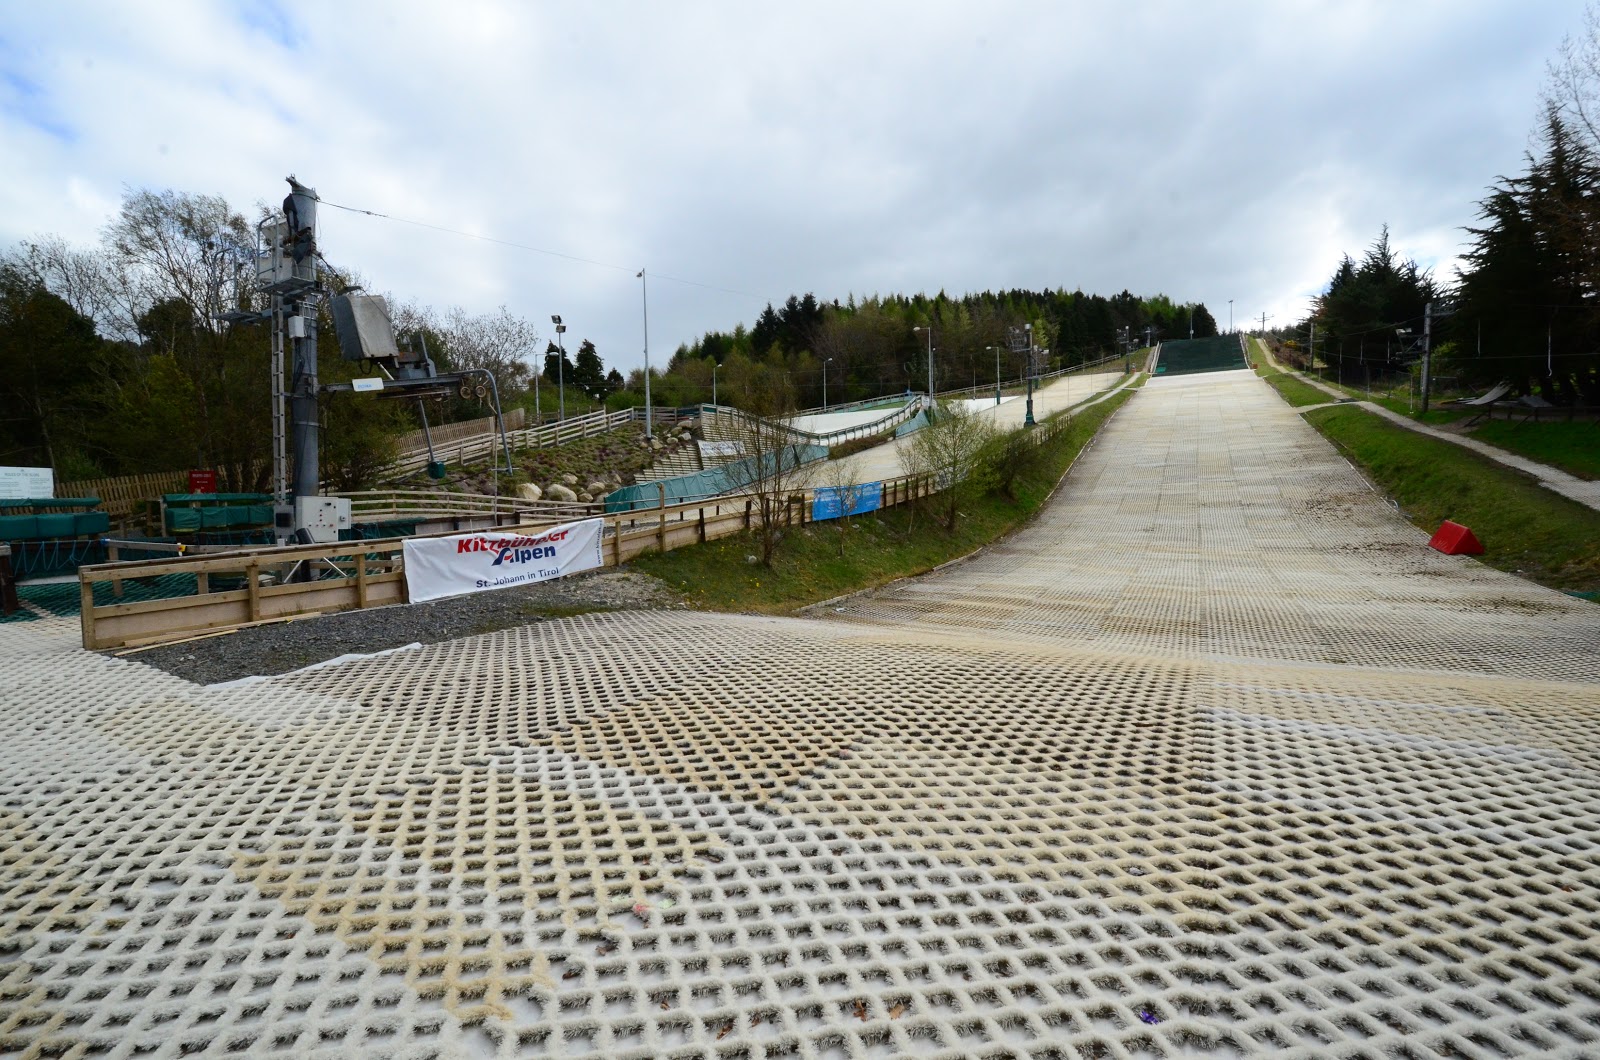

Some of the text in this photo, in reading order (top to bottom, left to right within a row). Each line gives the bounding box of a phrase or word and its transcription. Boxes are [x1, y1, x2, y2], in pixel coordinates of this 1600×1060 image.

[457, 529, 569, 554] Kitzbüheler
[491, 545, 556, 567] Alpen
[476, 567, 560, 588] St. Johann in Tirol
